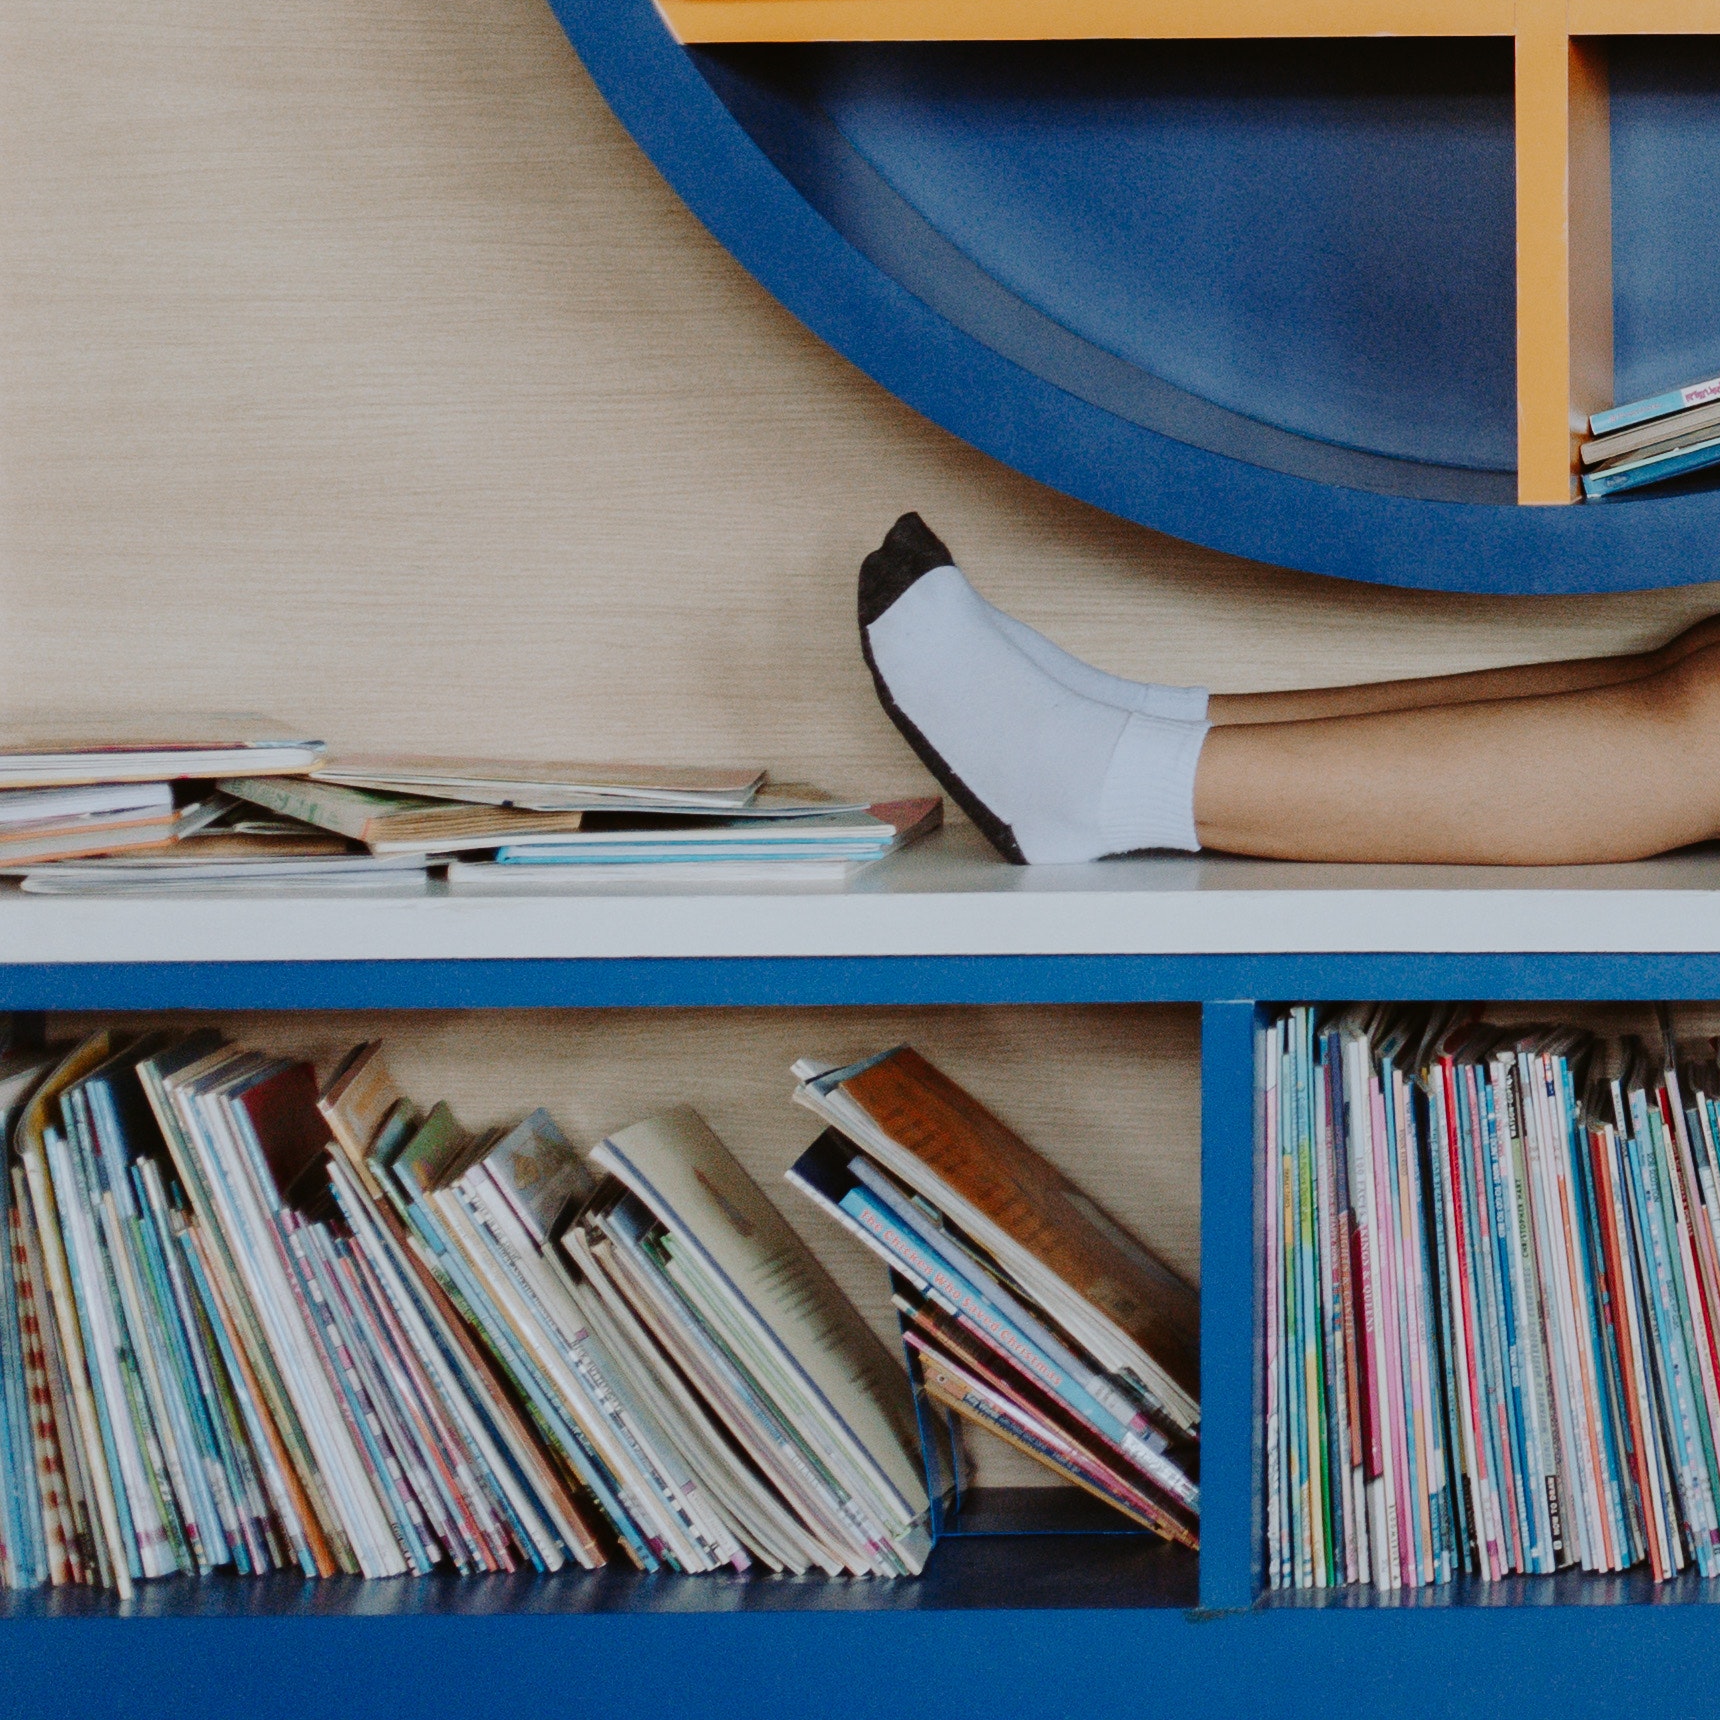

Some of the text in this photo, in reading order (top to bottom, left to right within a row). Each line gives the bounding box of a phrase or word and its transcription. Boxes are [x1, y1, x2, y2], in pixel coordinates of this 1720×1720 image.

[858, 1207, 1064, 1388] The Chicken Who Saved Christmas
[1514, 1178, 1560, 1535] HOW TO DRAW CHRISTOPHER HART
